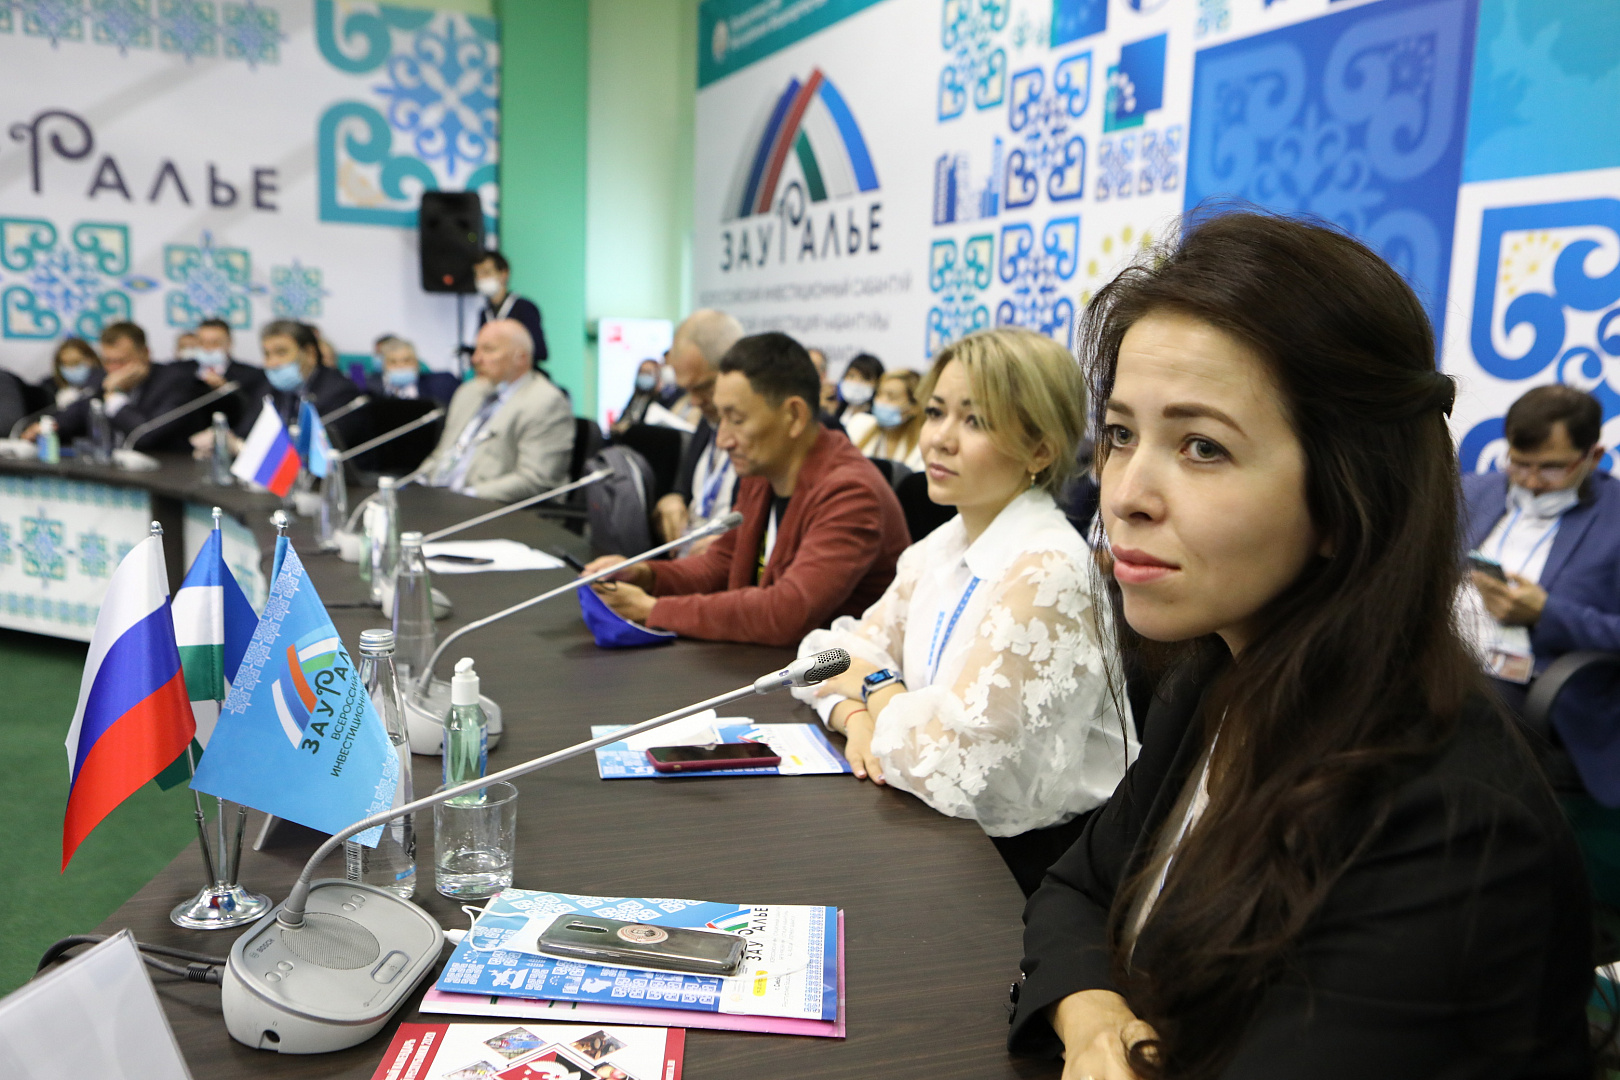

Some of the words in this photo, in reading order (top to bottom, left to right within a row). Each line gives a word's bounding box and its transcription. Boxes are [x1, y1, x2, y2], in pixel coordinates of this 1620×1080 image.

[5, 107, 280, 211] РАЛЬЕ
[720, 181, 883, 273] ЗАУРАЛЬЕ
[302, 640, 350, 754] ЗАУРАЛ
